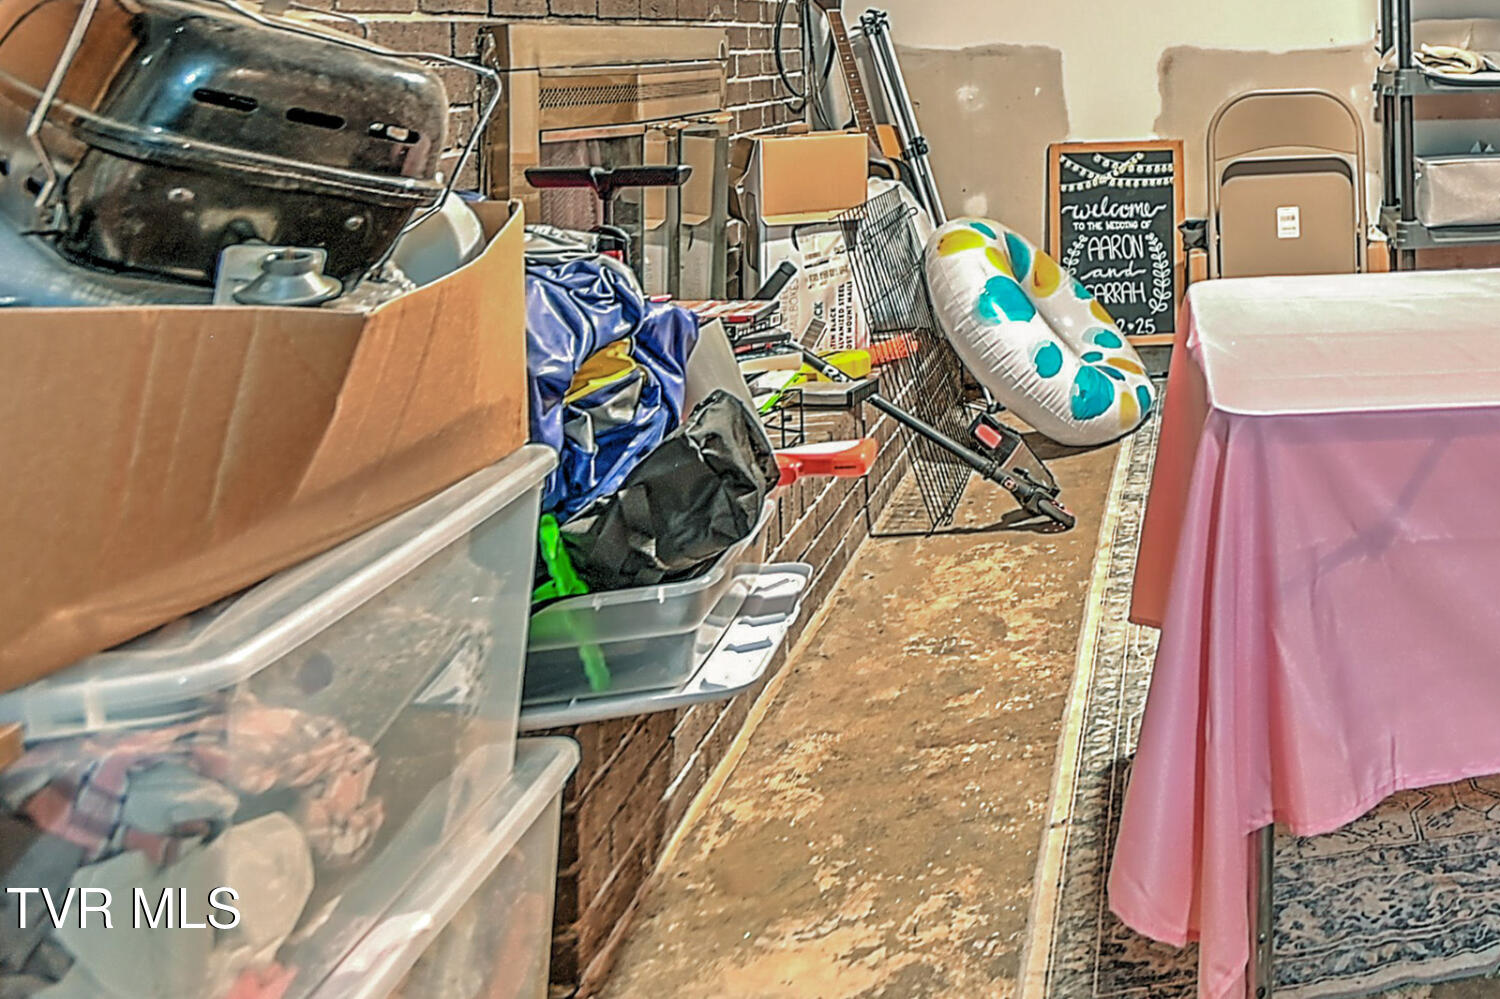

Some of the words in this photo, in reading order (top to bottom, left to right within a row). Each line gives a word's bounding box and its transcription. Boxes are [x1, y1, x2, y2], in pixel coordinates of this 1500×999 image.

[1061, 196, 1167, 219] welcome
[1073, 222, 1085, 231] TO
[1087, 221, 1103, 231] THE
[1140, 219, 1152, 229] OF
[1087, 234, 1144, 261] AARON
[1080, 260, 1146, 280] and
